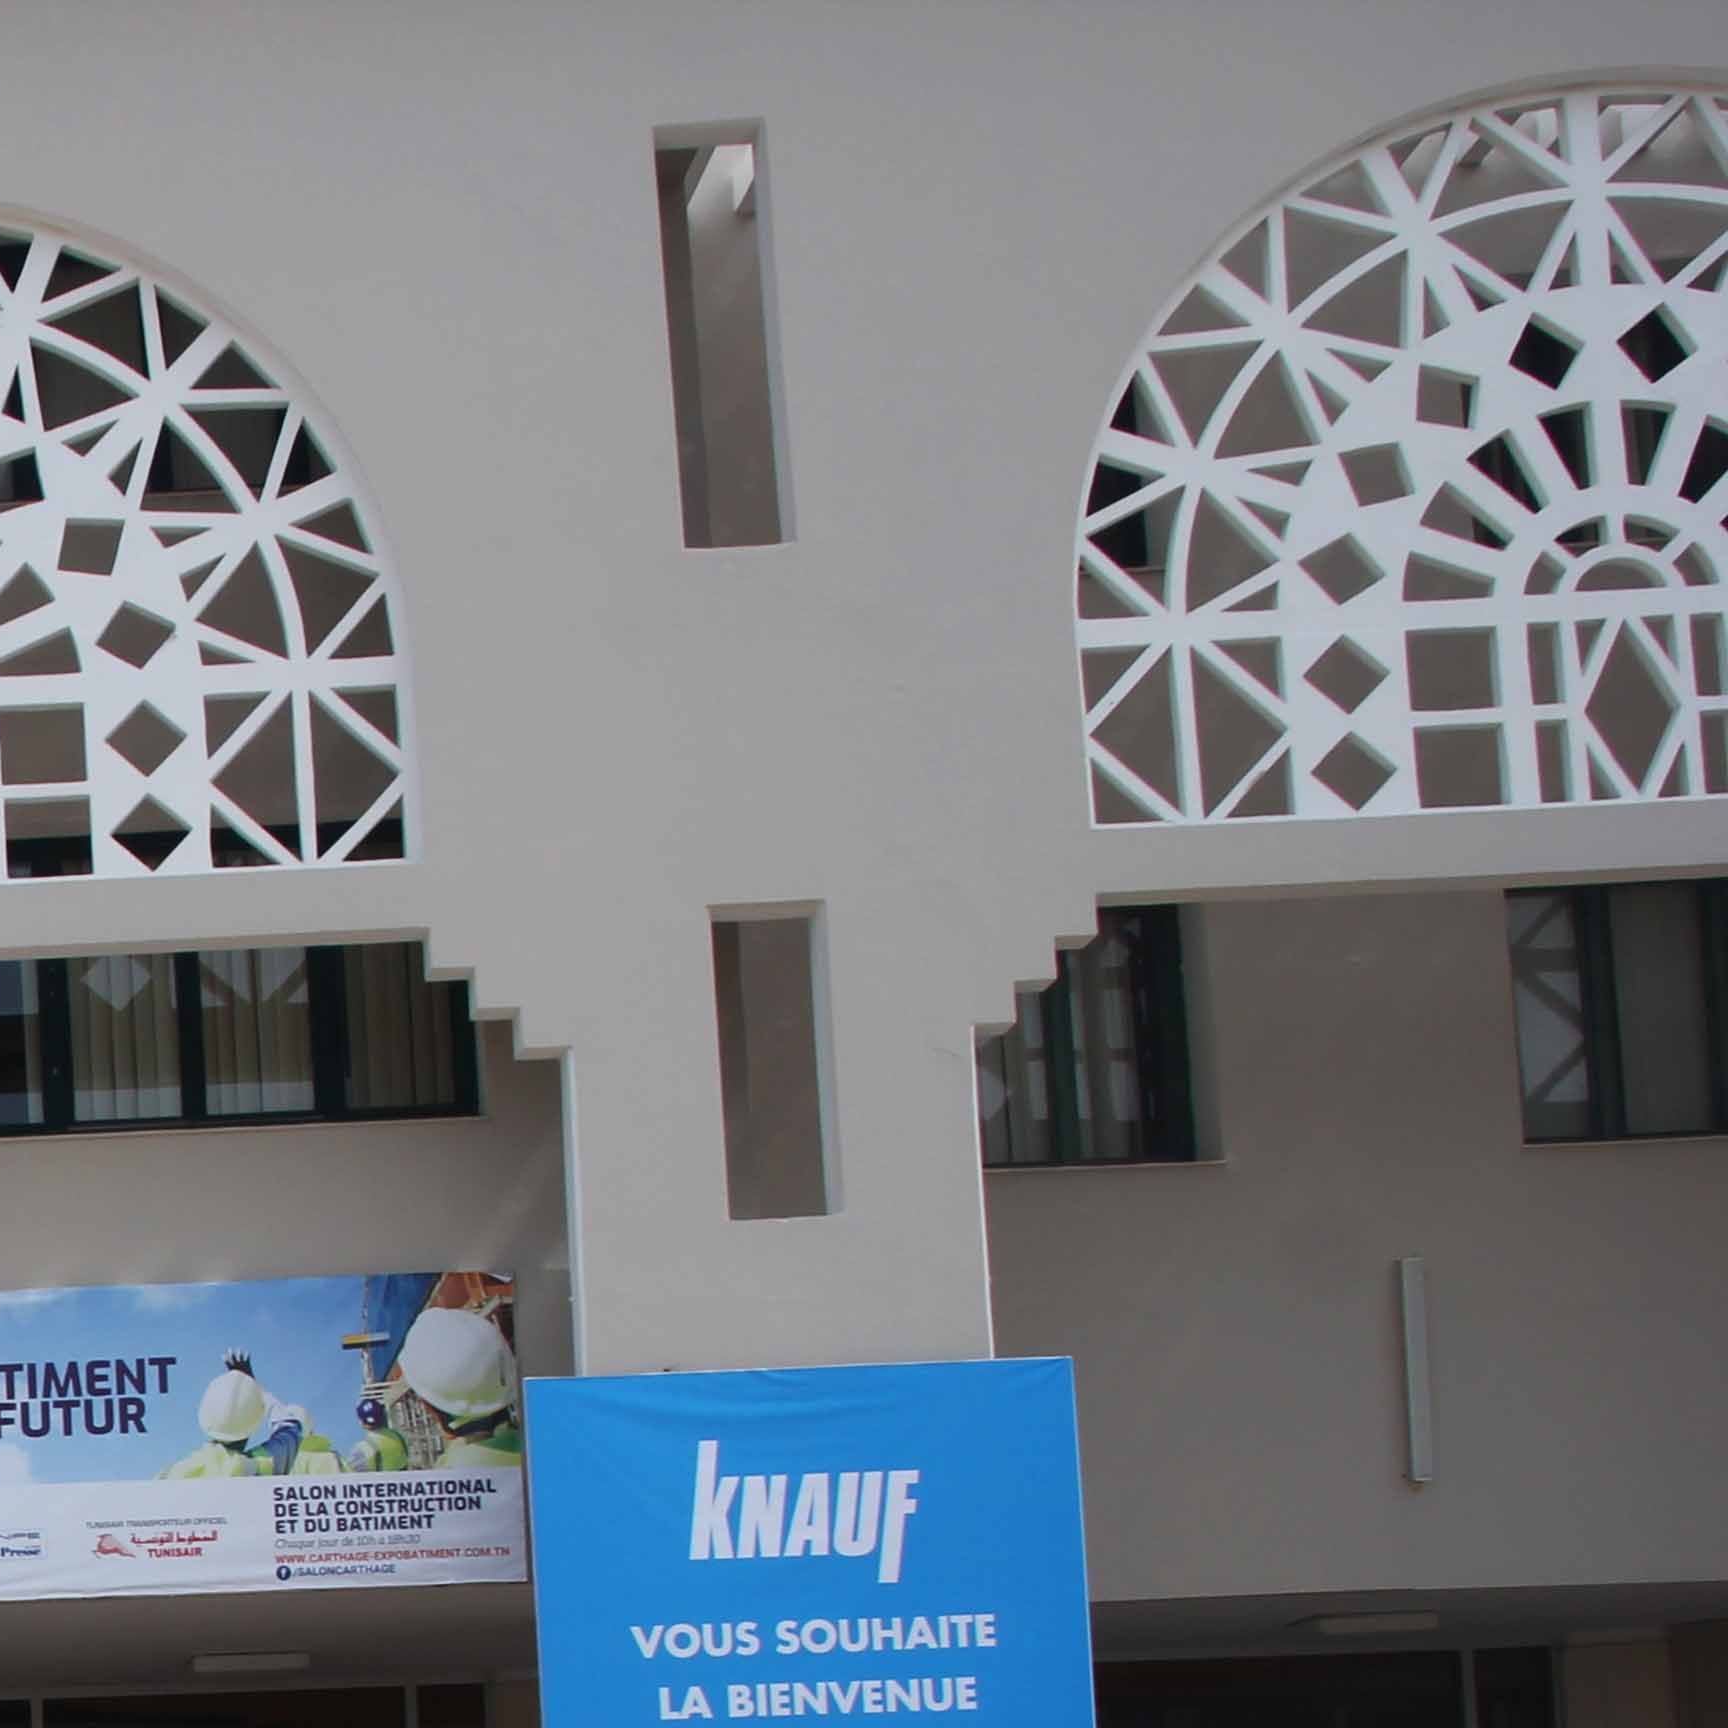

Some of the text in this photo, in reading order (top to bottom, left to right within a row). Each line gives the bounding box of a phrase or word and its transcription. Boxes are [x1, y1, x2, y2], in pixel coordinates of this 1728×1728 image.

[273, 1479, 496, 1502] SALON INTERNATIONAL
[274, 1496, 481, 1517] DE LA CONSTRUCTION
[688, 1440, 920, 1584] KNAUF
[275, 1514, 434, 1534] ET DU BATIMENT
[147, 1547, 202, 1558] TUNISAIR
[630, 1613, 997, 1659] VOUS SOUHAITE
[659, 1676, 978, 1721] LA BIENVENUE
